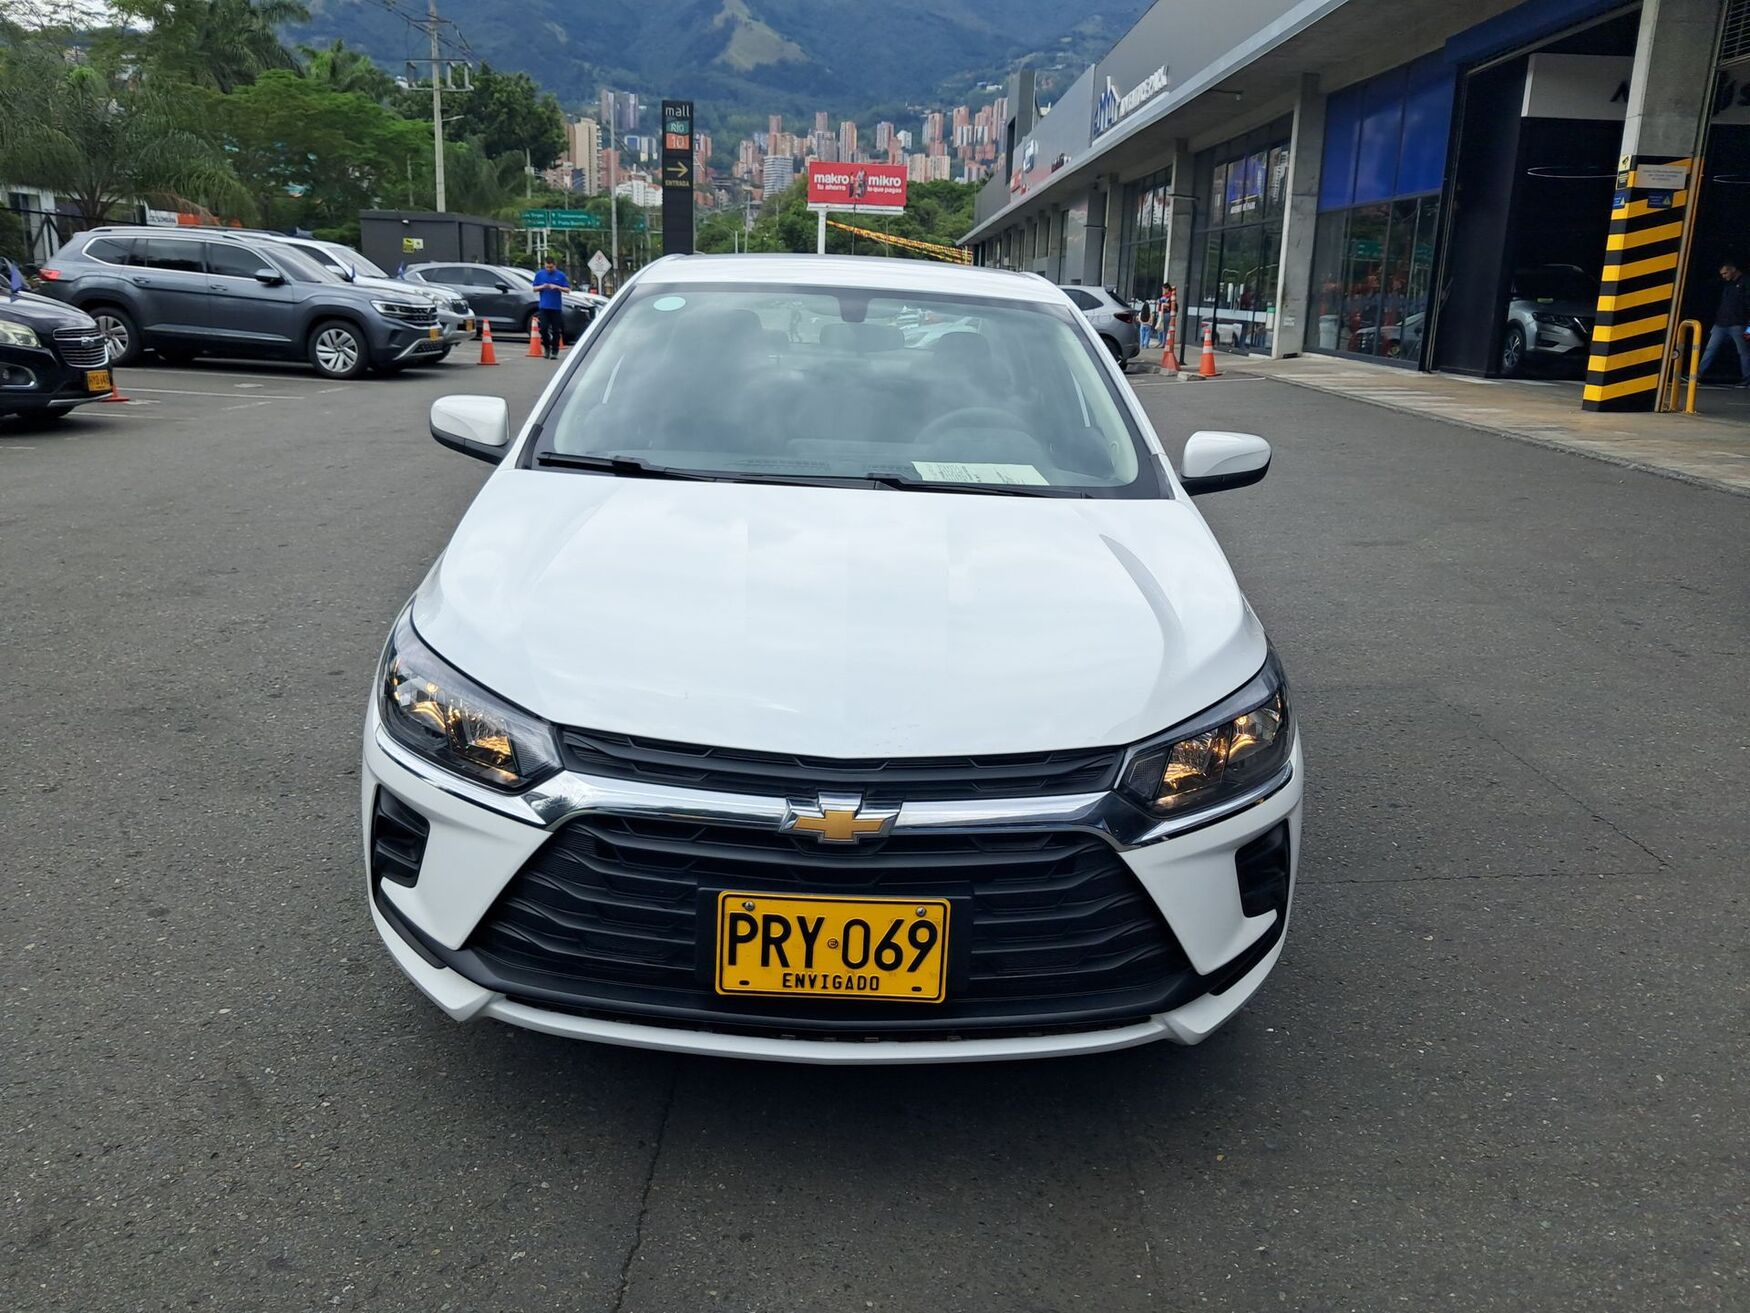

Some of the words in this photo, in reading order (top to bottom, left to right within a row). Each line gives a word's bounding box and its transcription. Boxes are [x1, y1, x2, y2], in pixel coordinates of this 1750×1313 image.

[665, 105, 690, 117] mall
[814, 172, 849, 184] makro
[868, 174, 902, 187] mikro
[727, 912, 826, 969] PRY
[841, 918, 938, 973] 069
[782, 972, 880, 991] ENVIGADO
